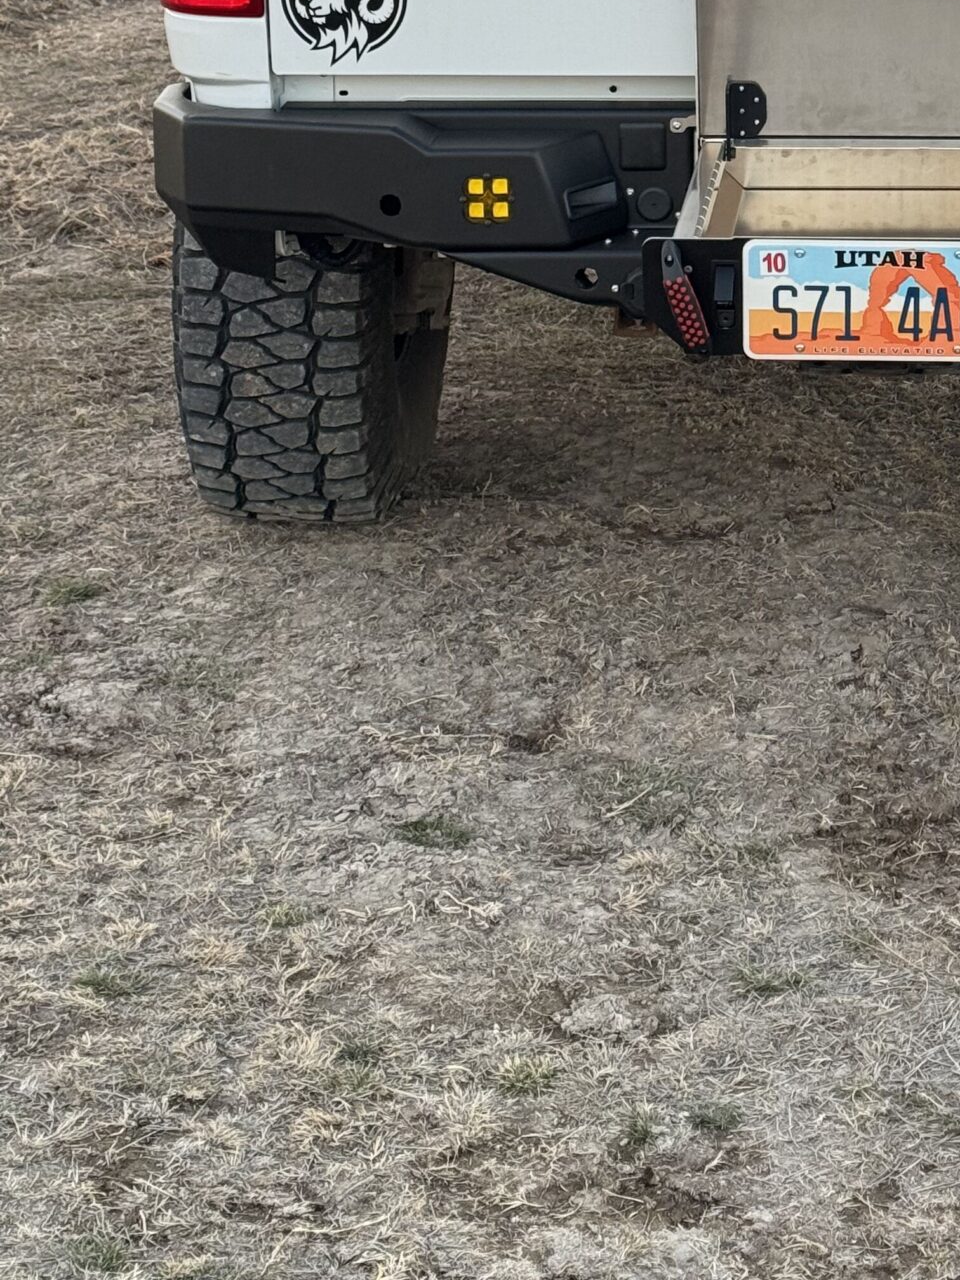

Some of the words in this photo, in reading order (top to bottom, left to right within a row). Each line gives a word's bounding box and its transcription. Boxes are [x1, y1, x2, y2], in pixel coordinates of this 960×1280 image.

[762, 252, 786, 273] 10
[834, 250, 926, 269] UTAH
[772, 284, 860, 341] S71
